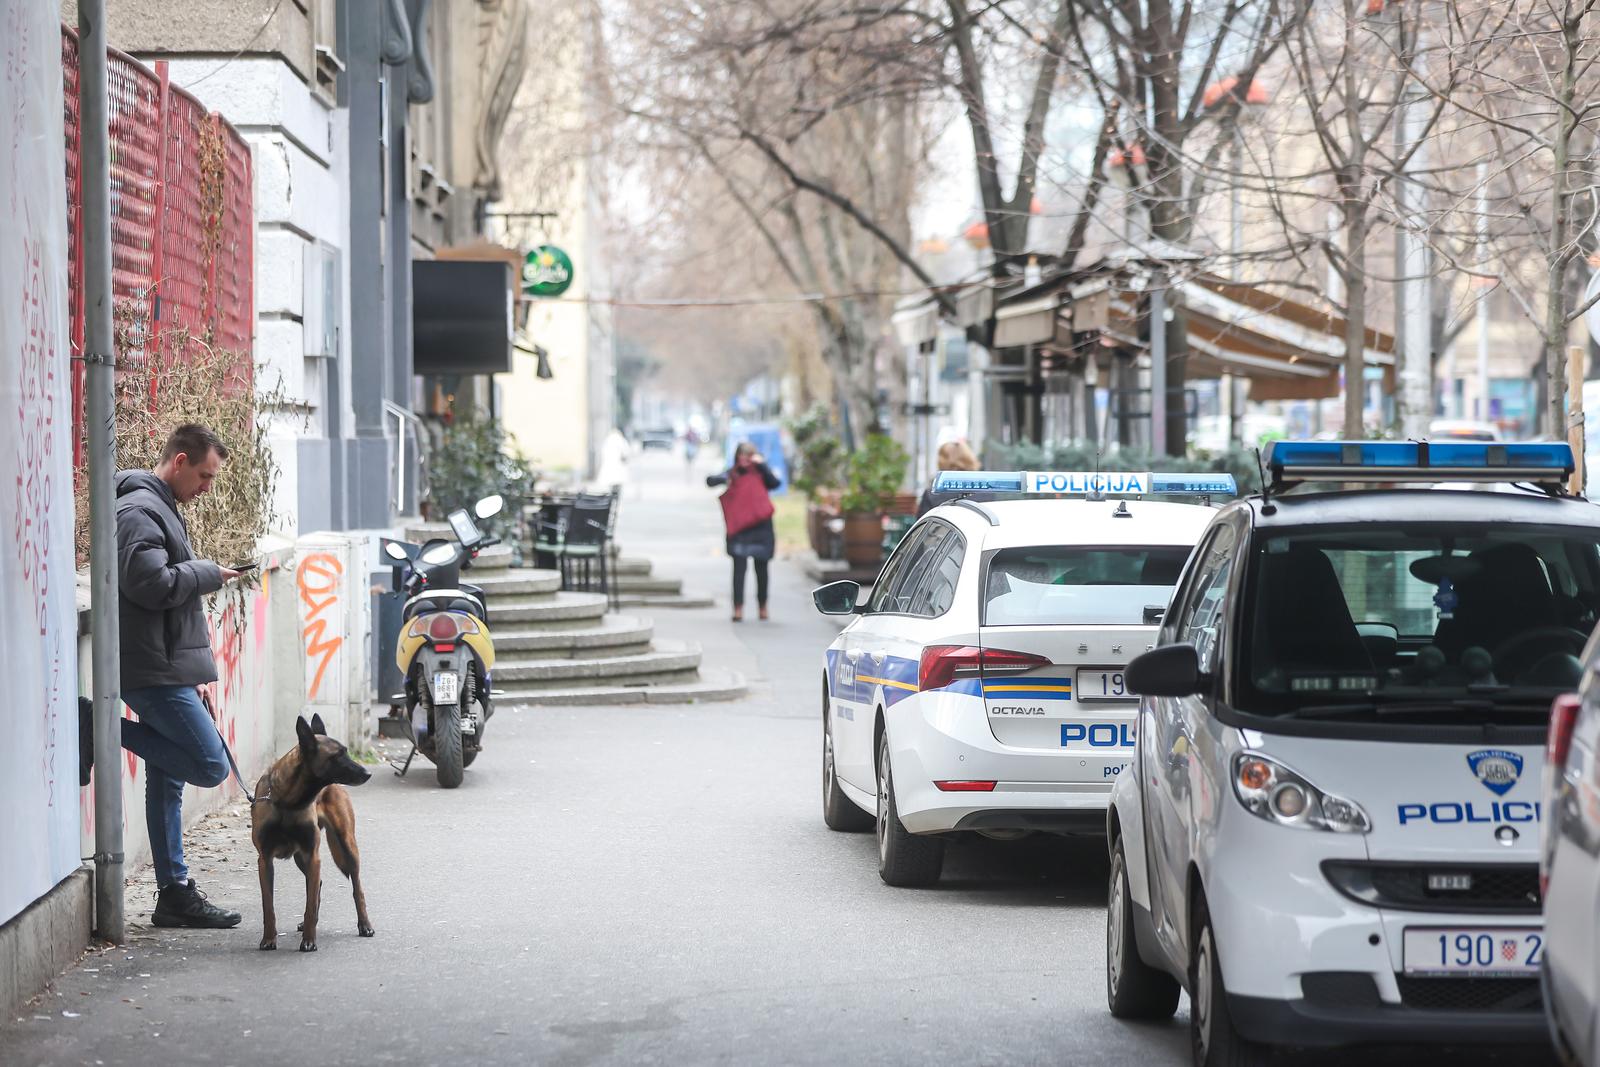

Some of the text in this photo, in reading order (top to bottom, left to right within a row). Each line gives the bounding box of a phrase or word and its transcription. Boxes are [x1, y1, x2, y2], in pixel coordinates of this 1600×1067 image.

[24, 431, 34, 581] OTAC
[29, 239, 40, 401] SJEDE
[1036, 474, 1142, 491] POLICIJA
[40, 474, 51, 636] DUGO
[1101, 673, 1124, 696] 19
[992, 706, 1045, 715] OCTAVIA
[1061, 724, 1135, 747] POL
[1439, 934, 1541, 966] 190 2
